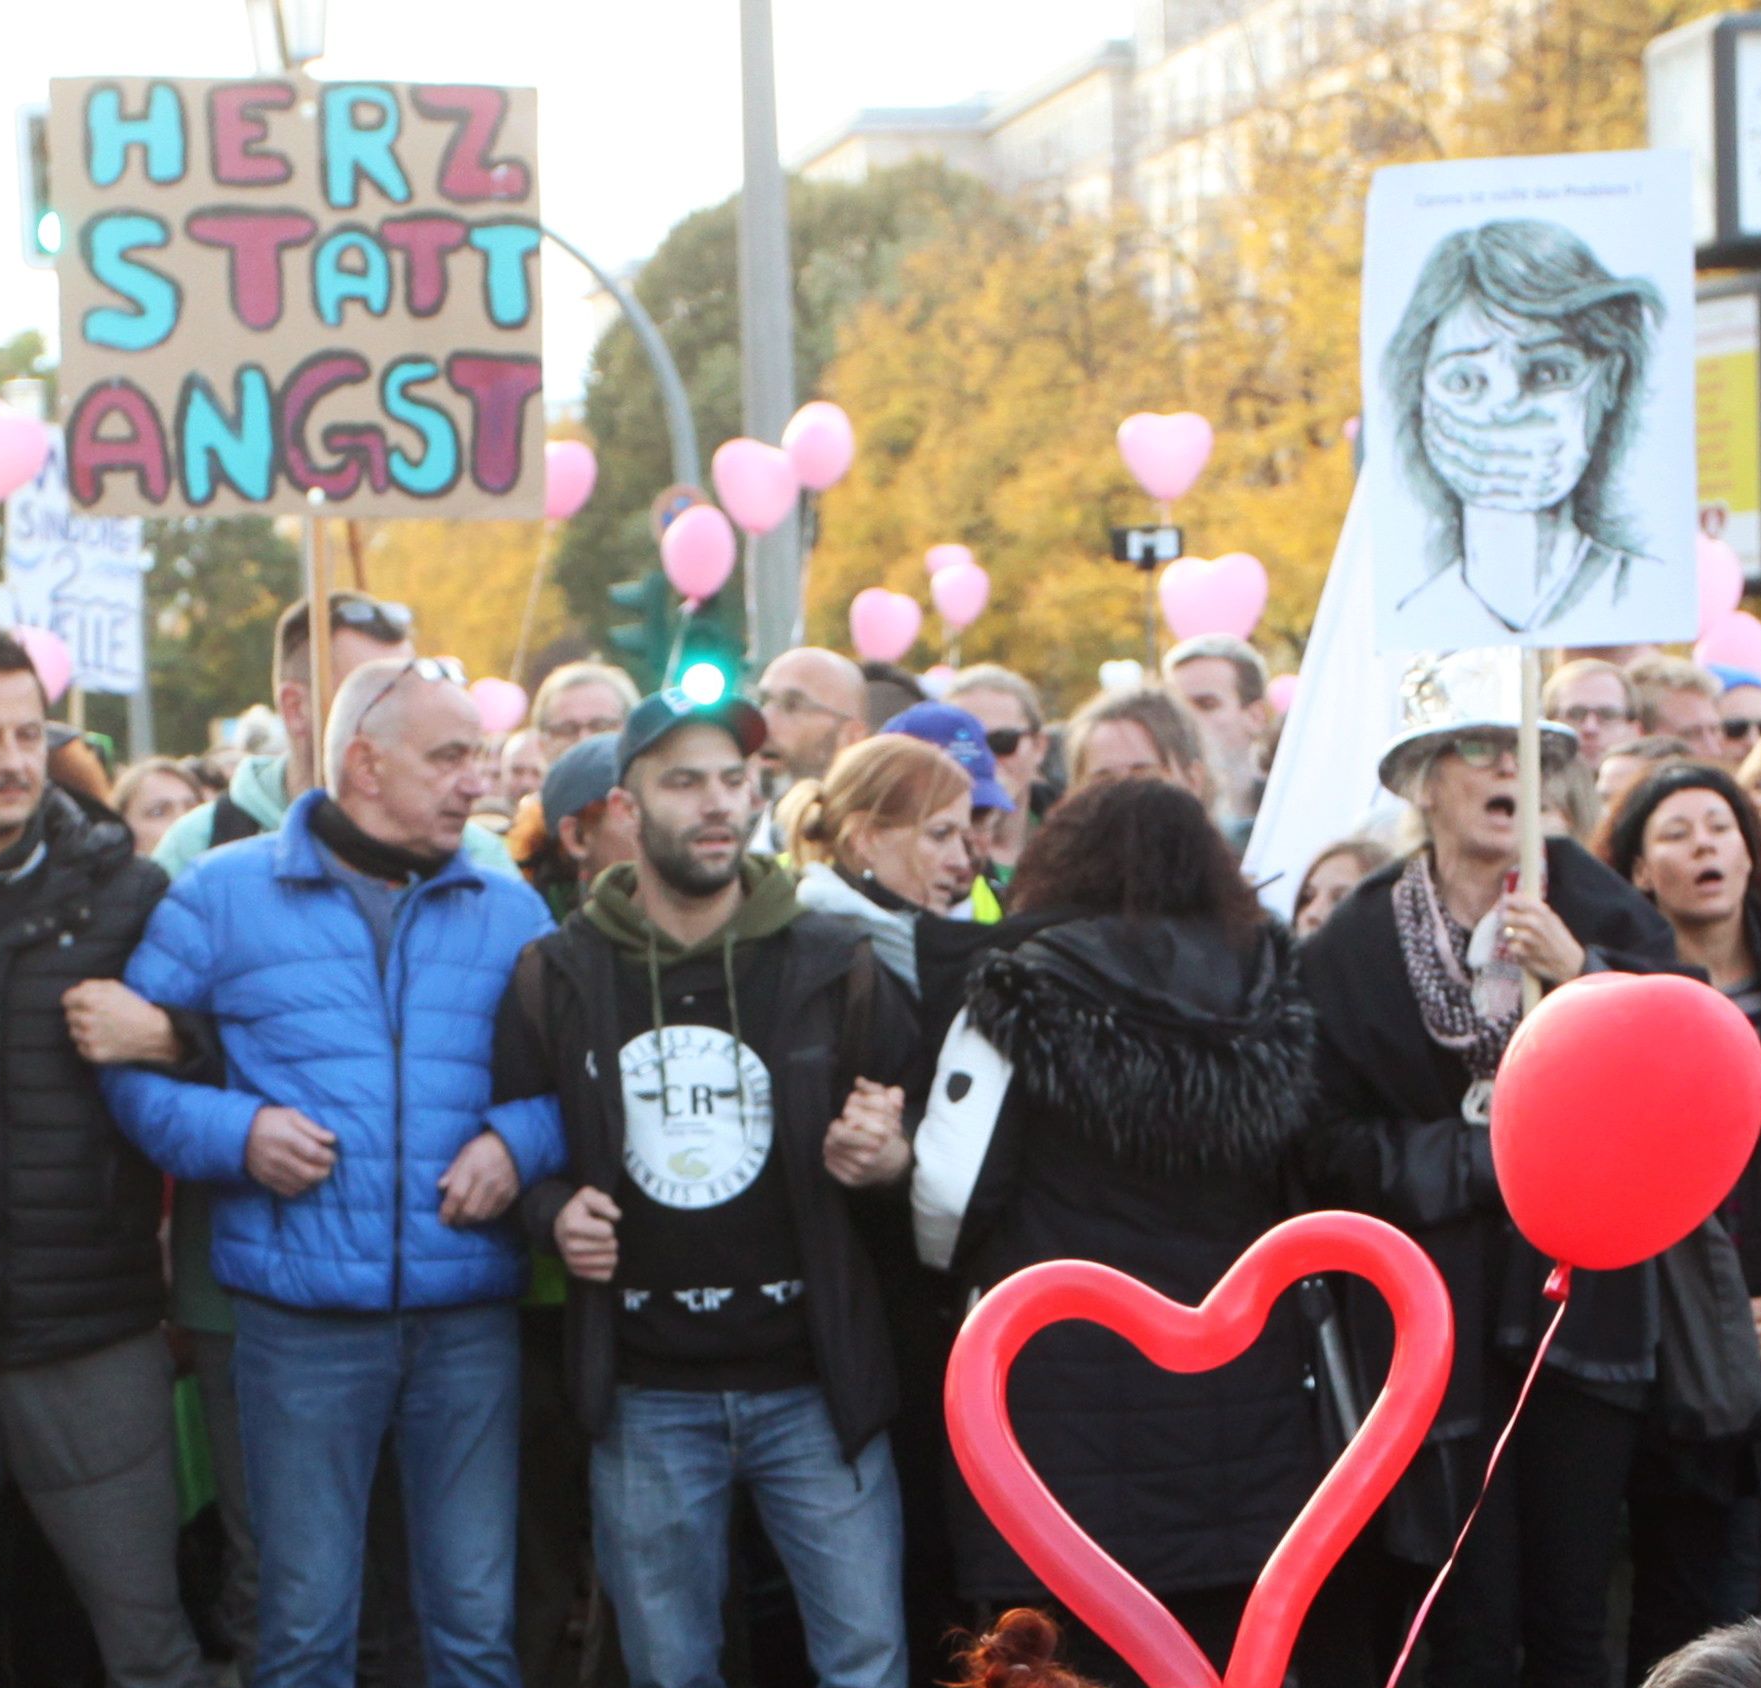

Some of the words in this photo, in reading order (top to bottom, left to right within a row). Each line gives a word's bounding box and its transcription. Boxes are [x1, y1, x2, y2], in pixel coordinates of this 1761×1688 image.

[84, 78, 531, 209] HERZ
[79, 204, 541, 352] STATT
[64, 347, 542, 507] ANGST
